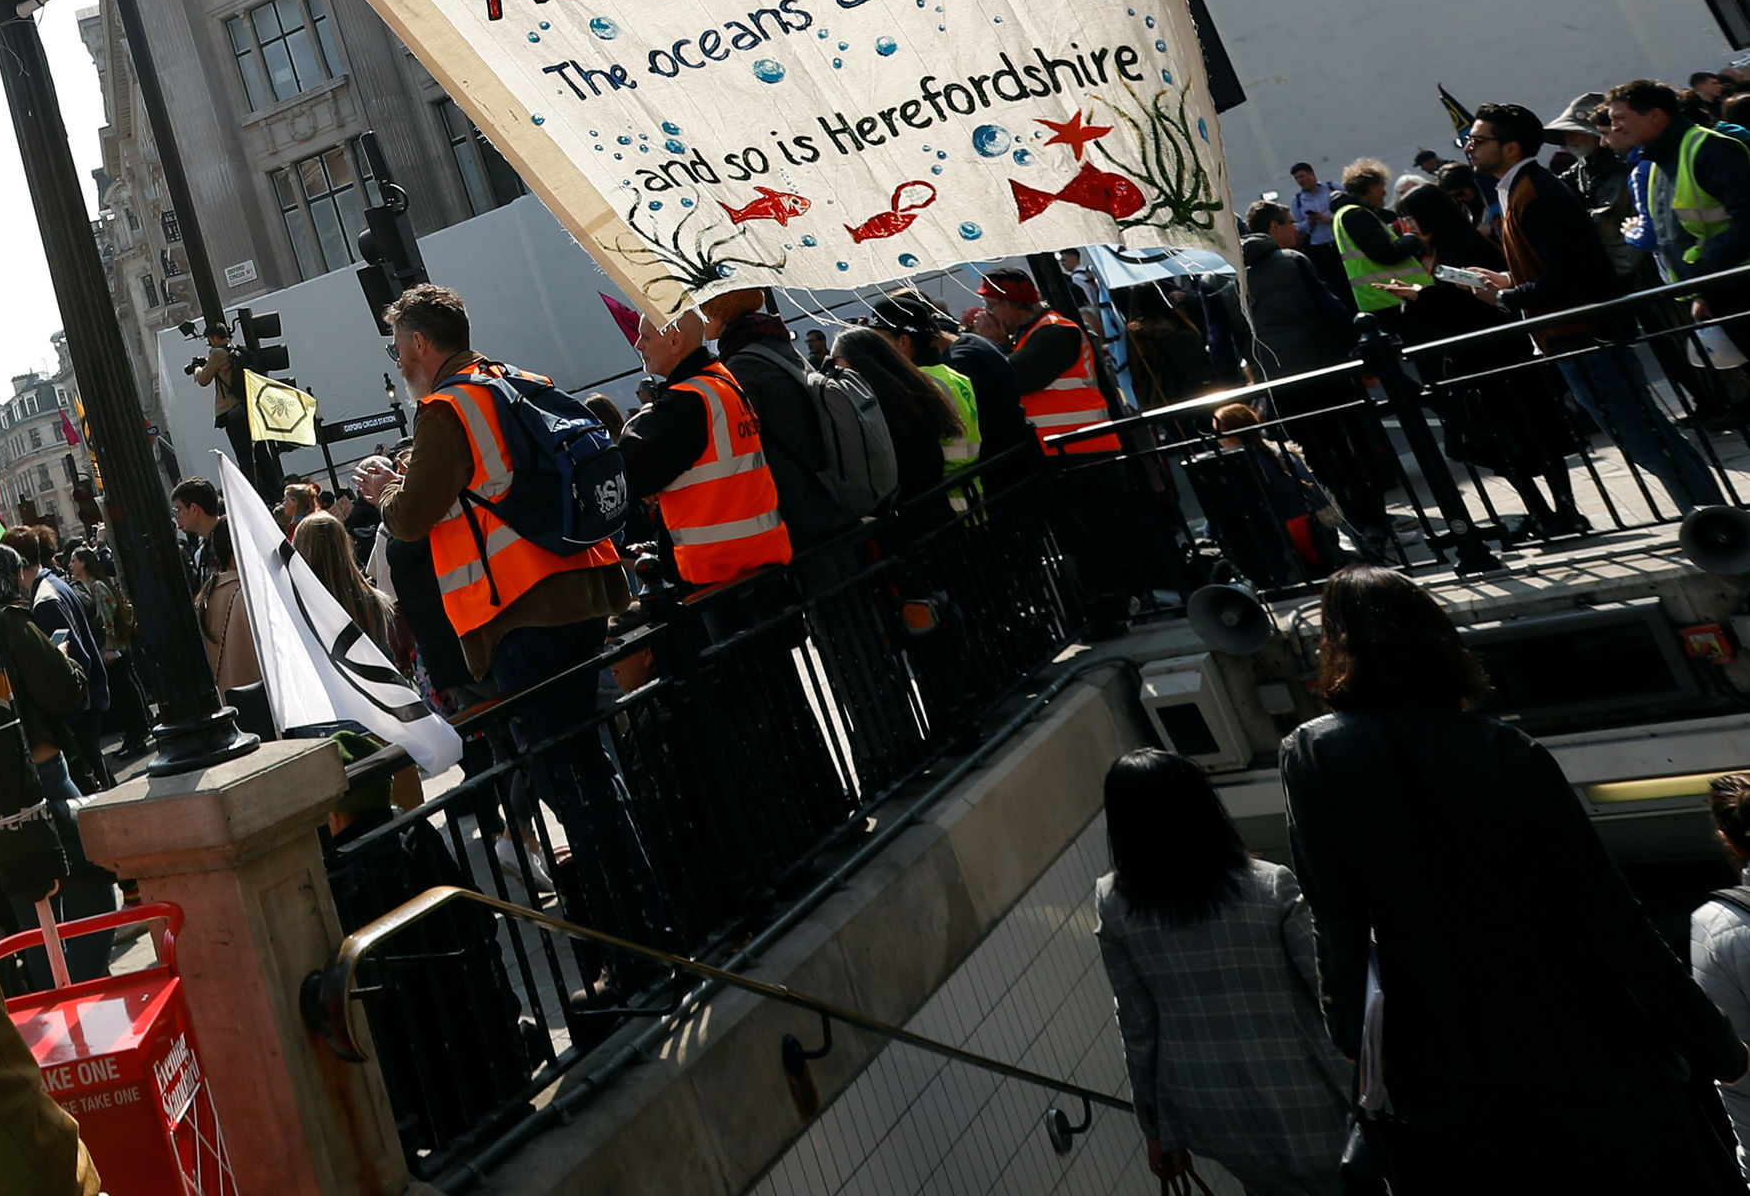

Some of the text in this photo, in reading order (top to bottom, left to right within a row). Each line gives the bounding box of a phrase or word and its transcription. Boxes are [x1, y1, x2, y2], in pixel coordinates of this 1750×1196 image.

[545, 61, 637, 103] The
[636, 43, 1145, 193] and so is Herefordshire
[41, 1057, 120, 1092] AKE ONE
[153, 1032, 191, 1096] Evening
[162, 1048, 201, 1127] Standard
[79, 1093, 112, 1112] TAKE
[114, 1086, 142, 1105] ONE
